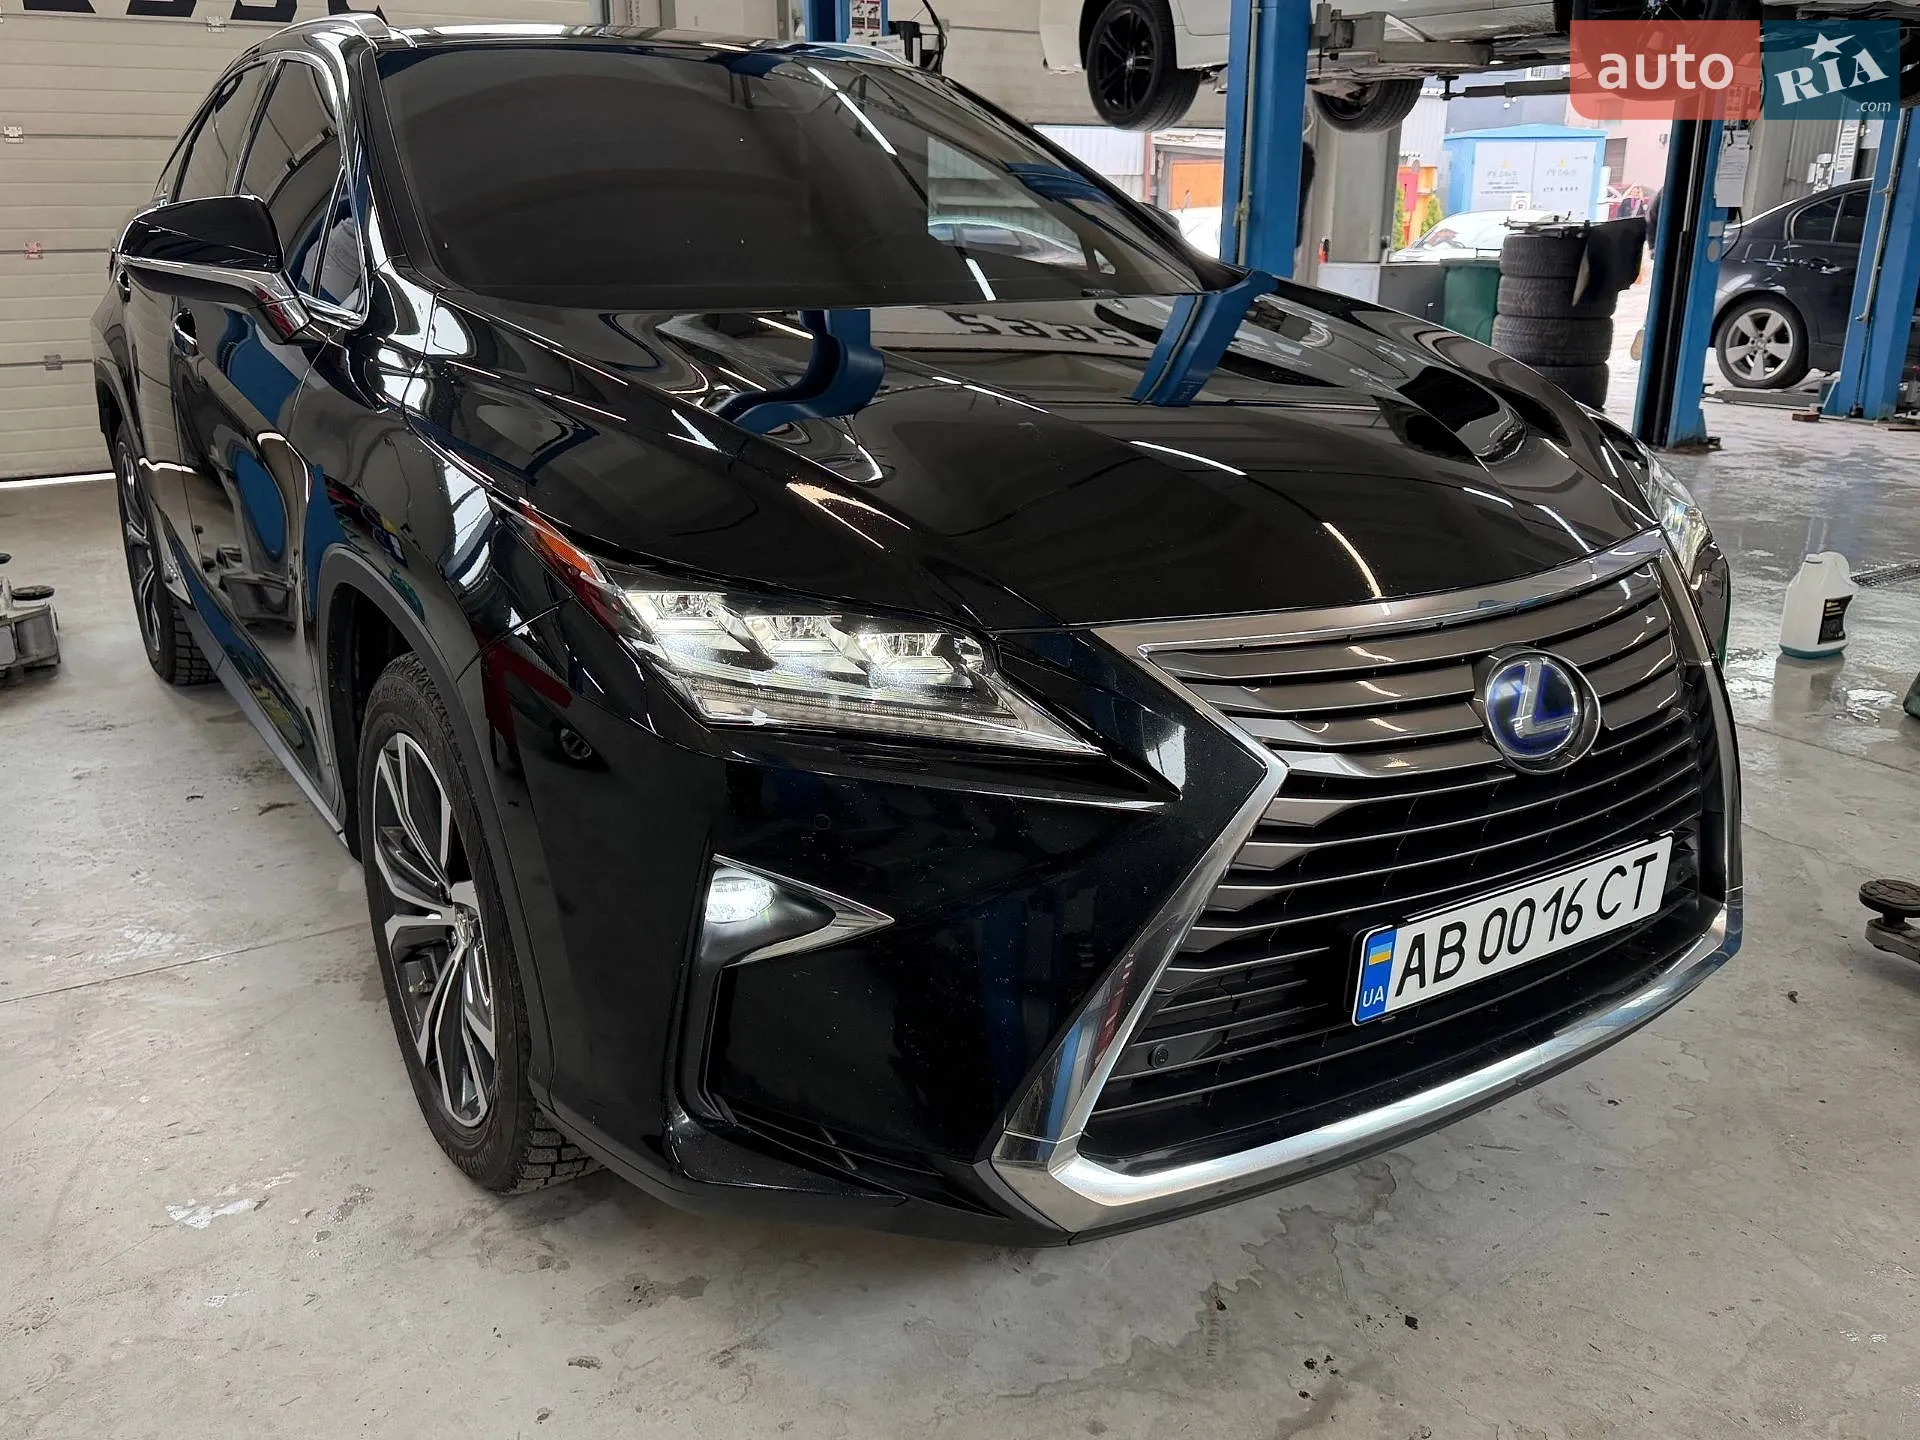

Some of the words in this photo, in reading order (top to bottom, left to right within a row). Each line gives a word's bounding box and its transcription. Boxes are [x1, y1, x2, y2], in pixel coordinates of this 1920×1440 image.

[1395, 920, 1467, 997] AB
[1480, 879, 1588, 966] 0016
[1597, 853, 1658, 920] CT
[1362, 985, 1385, 1008] UA
